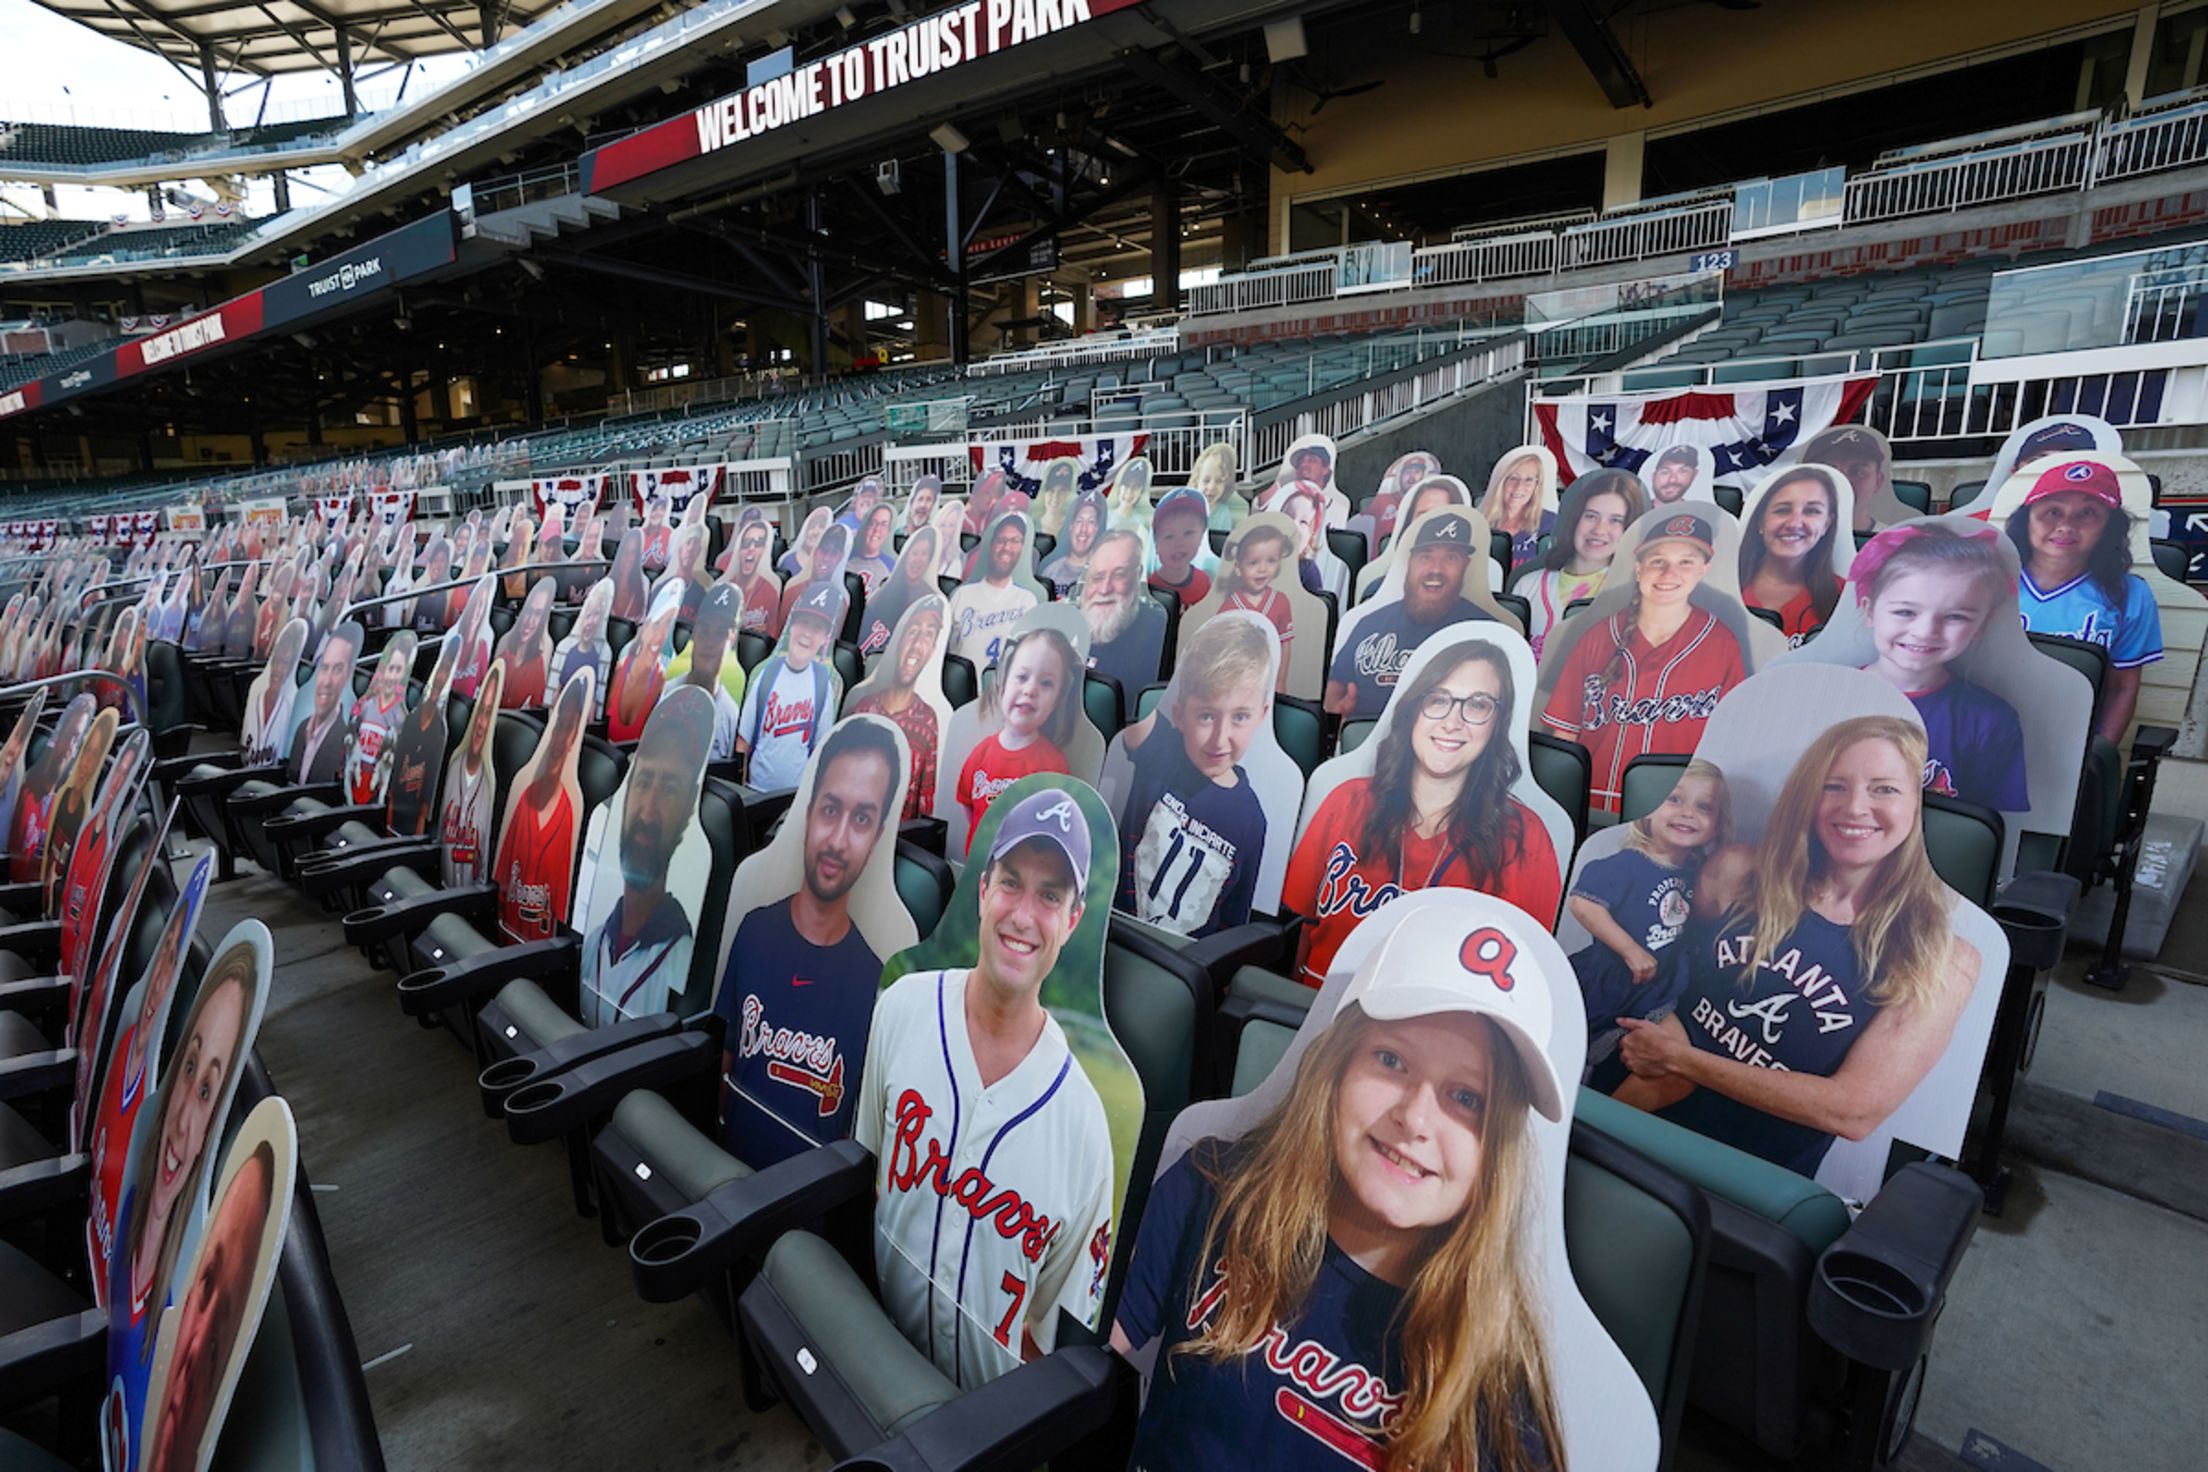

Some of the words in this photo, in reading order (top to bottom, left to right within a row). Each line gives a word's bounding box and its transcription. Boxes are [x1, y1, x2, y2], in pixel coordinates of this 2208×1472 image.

[696, 62, 824, 154] WELCOME
[826, 47, 866, 107] TO
[868, 2, 982, 96] TRUIST
[308, 273, 340, 297] TRUIST
[354, 257, 381, 280] PARK
[1698, 252, 1731, 271] 123
[1435, 519, 1458, 538] A
[1036, 800, 1073, 832] A
[1316, 841, 1412, 918] Bra
[1717, 936, 1853, 1034] ATANTA
[1728, 993, 1799, 1044] A
[739, 994, 836, 1073] Braves
[888, 1089, 1063, 1264] Braves
[994, 1270, 1026, 1348] 7
